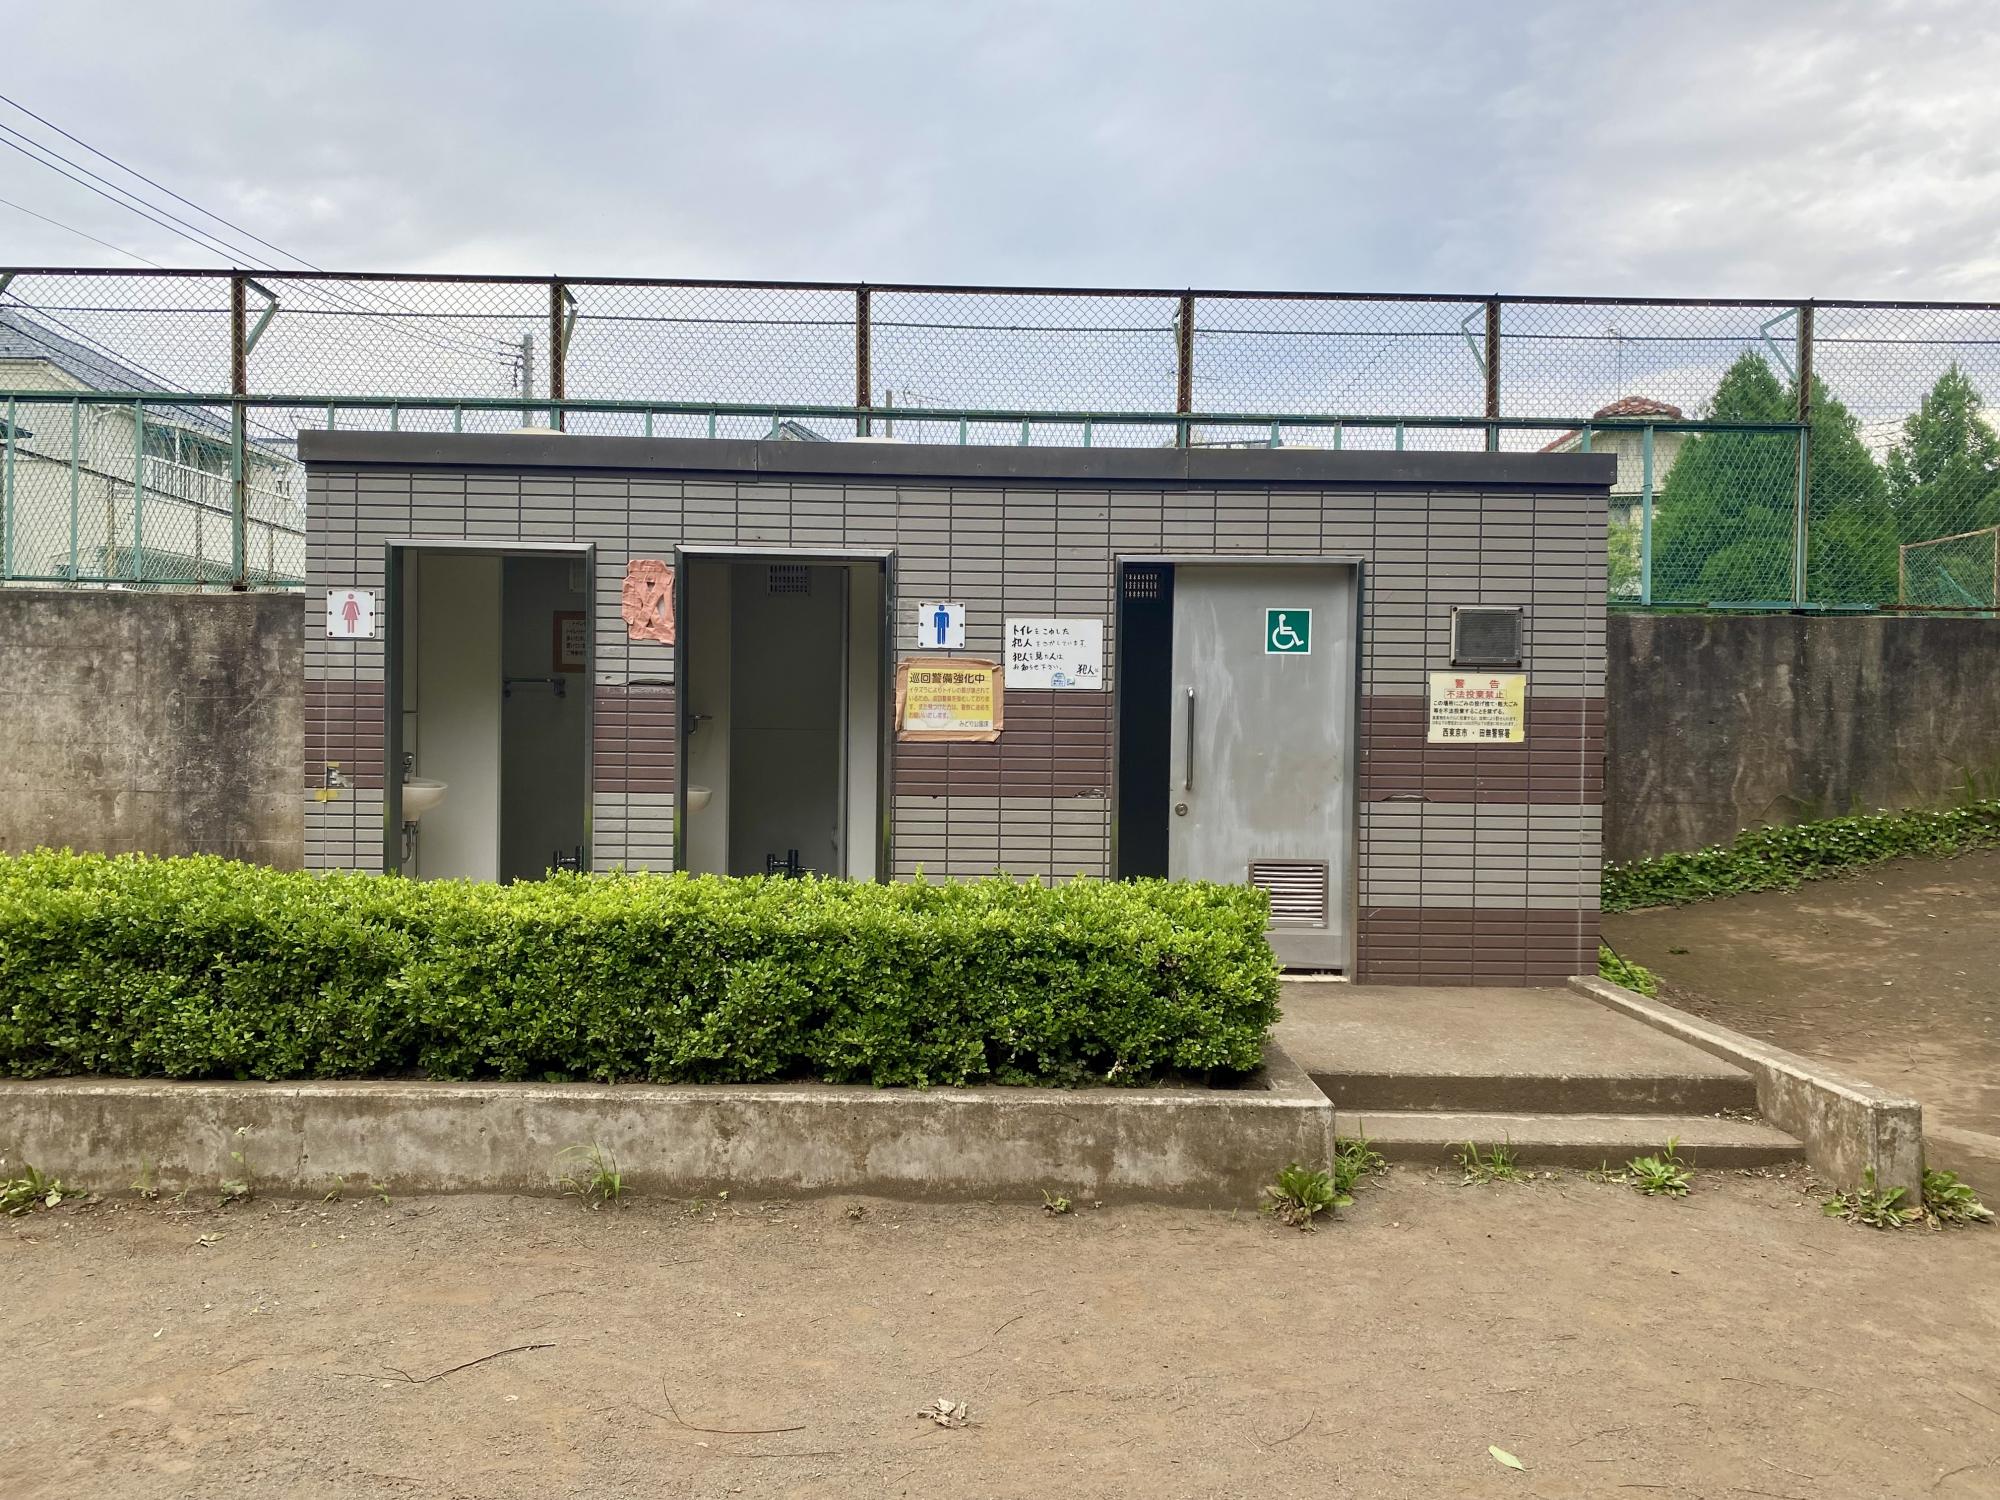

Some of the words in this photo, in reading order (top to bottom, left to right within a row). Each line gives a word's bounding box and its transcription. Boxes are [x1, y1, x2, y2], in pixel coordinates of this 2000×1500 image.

[1013, 651, 1064, 662] 犯人を見た人は
[909, 672, 985, 684] 巡回警備強化中
[1447, 690, 1505, 699] 不法投棄禁止
